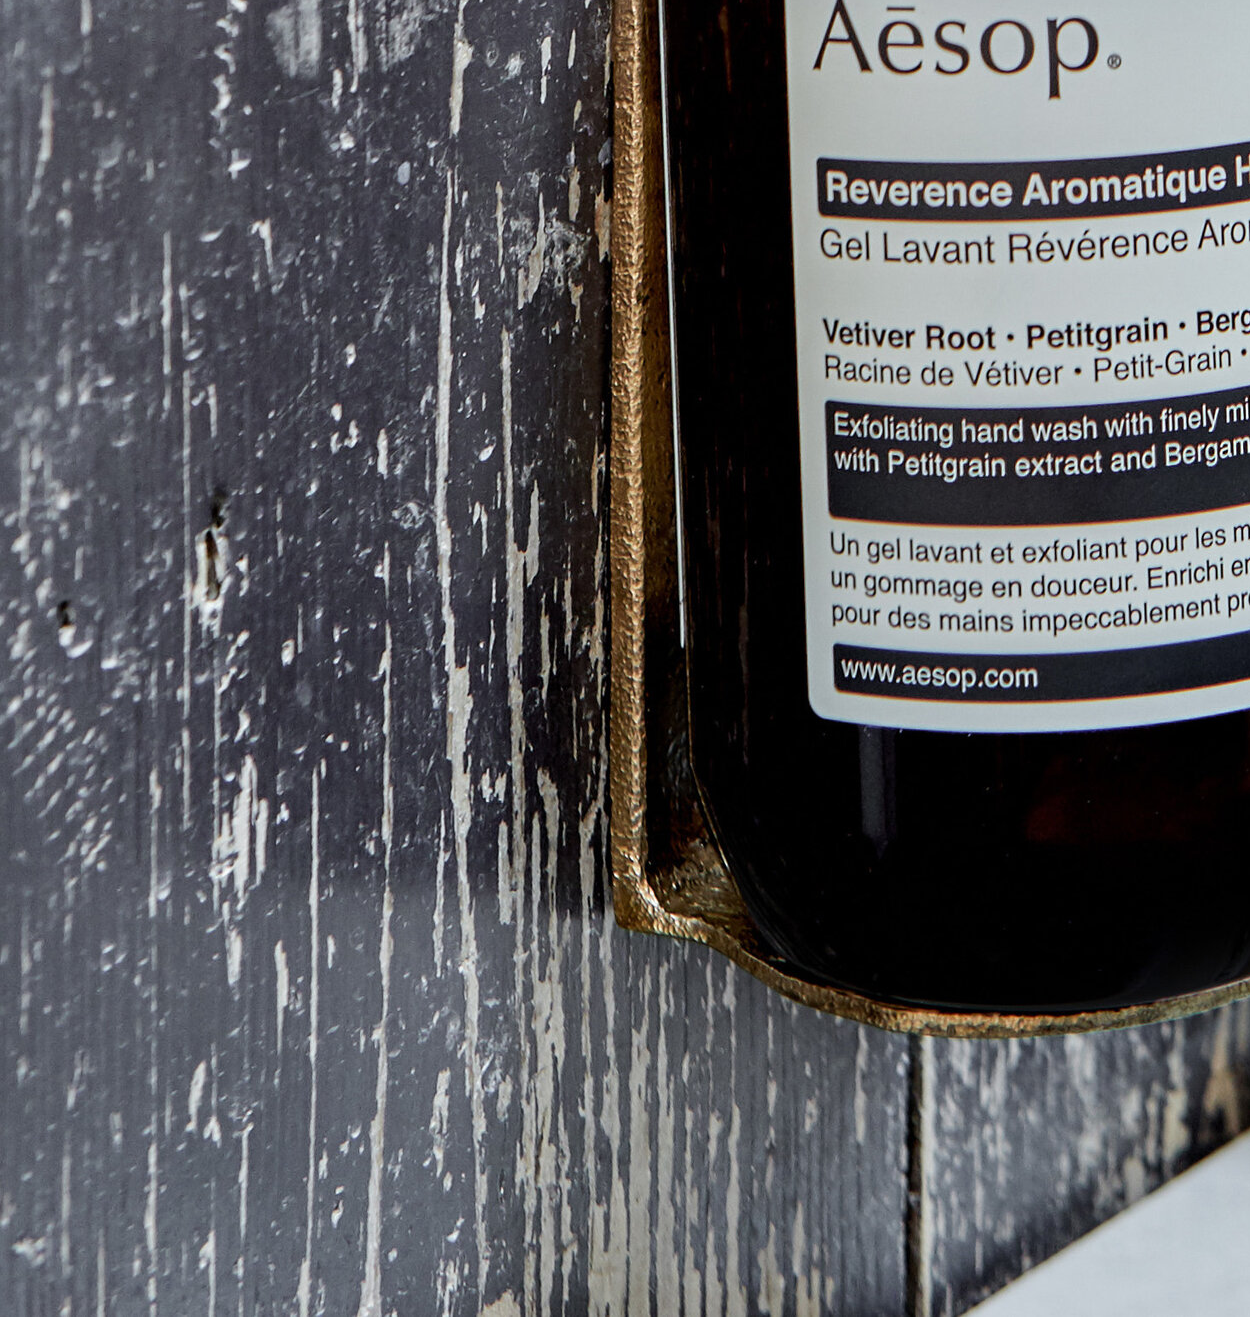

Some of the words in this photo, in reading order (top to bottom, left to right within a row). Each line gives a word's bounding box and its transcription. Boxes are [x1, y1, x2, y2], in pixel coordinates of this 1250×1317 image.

[826, 170, 1013, 208] Reverence
[1022, 164, 1227, 206] Aromatique
[820, 228, 870, 261] Gel
[883, 232, 995, 264] Lavant
[1008, 229, 1188, 263] Révérence
[822, 318, 916, 349] Vetiver
[925, 324, 996, 350] Root
[1026, 316, 1168, 352] Petitgrain
[824, 353, 911, 385] Racine
[920, 360, 954, 387] de
[964, 360, 1064, 387] Vétiver
[1093, 344, 1232, 383] Petit-Grain
[834, 411, 954, 449] Exfoliating
[961, 418, 1024, 444] hand
[1030, 415, 1098, 442] wash
[1104, 411, 1153, 438] with
[1159, 403, 1220, 433] finely
[833, 447, 880, 473] with
[888, 450, 1006, 483] Petitgrain
[1014, 450, 1103, 477] extract
[1110, 444, 1157, 473] and
[830, 531, 860, 557] Un
[866, 537, 901, 565] gel
[909, 538, 982, 564] lavant
[990, 542, 1014, 564] et
[1022, 537, 1127, 564] exfoliant
[1135, 533, 1188, 563] pour
[1195, 526, 1227, 550] les
[830, 570, 857, 590] un
[863, 574, 983, 604] gommage
[991, 580, 1022, 598] en
[1030, 574, 1138, 598] douceur.
[1147, 557, 1224, 590] Enrichi
[831, 604, 881, 627] pour
[887, 605, 931, 630] des
[939, 609, 1014, 633] mains
[1022, 593, 1221, 637] impeccablement
[841, 659, 1039, 694] www.aesop.com
